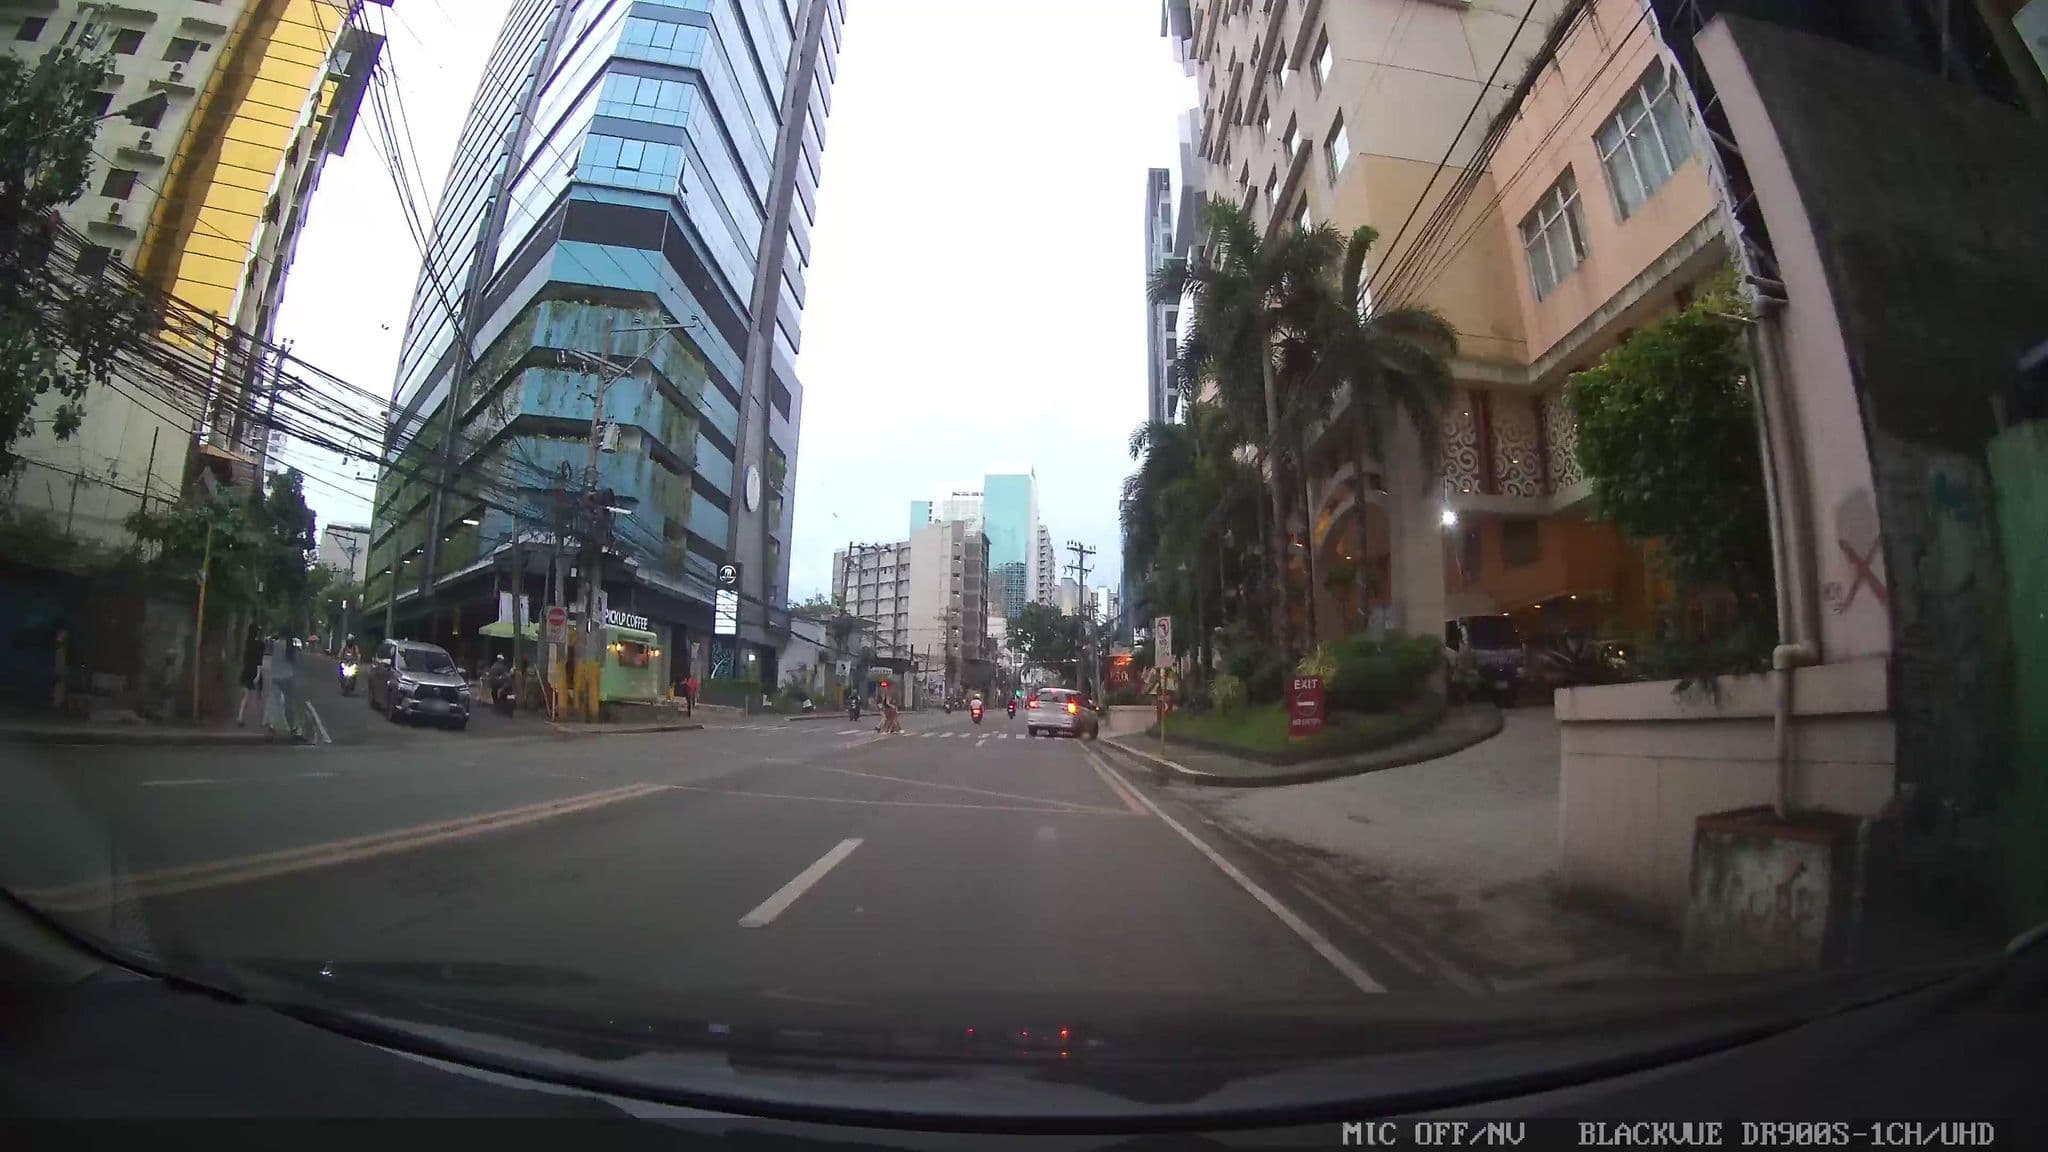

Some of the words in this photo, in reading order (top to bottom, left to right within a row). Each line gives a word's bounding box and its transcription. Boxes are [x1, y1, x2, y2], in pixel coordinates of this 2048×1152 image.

[605, 609, 626, 626] PICKUP
[626, 614, 648, 631] COFFEE
[1294, 679, 1318, 690] EXIT
